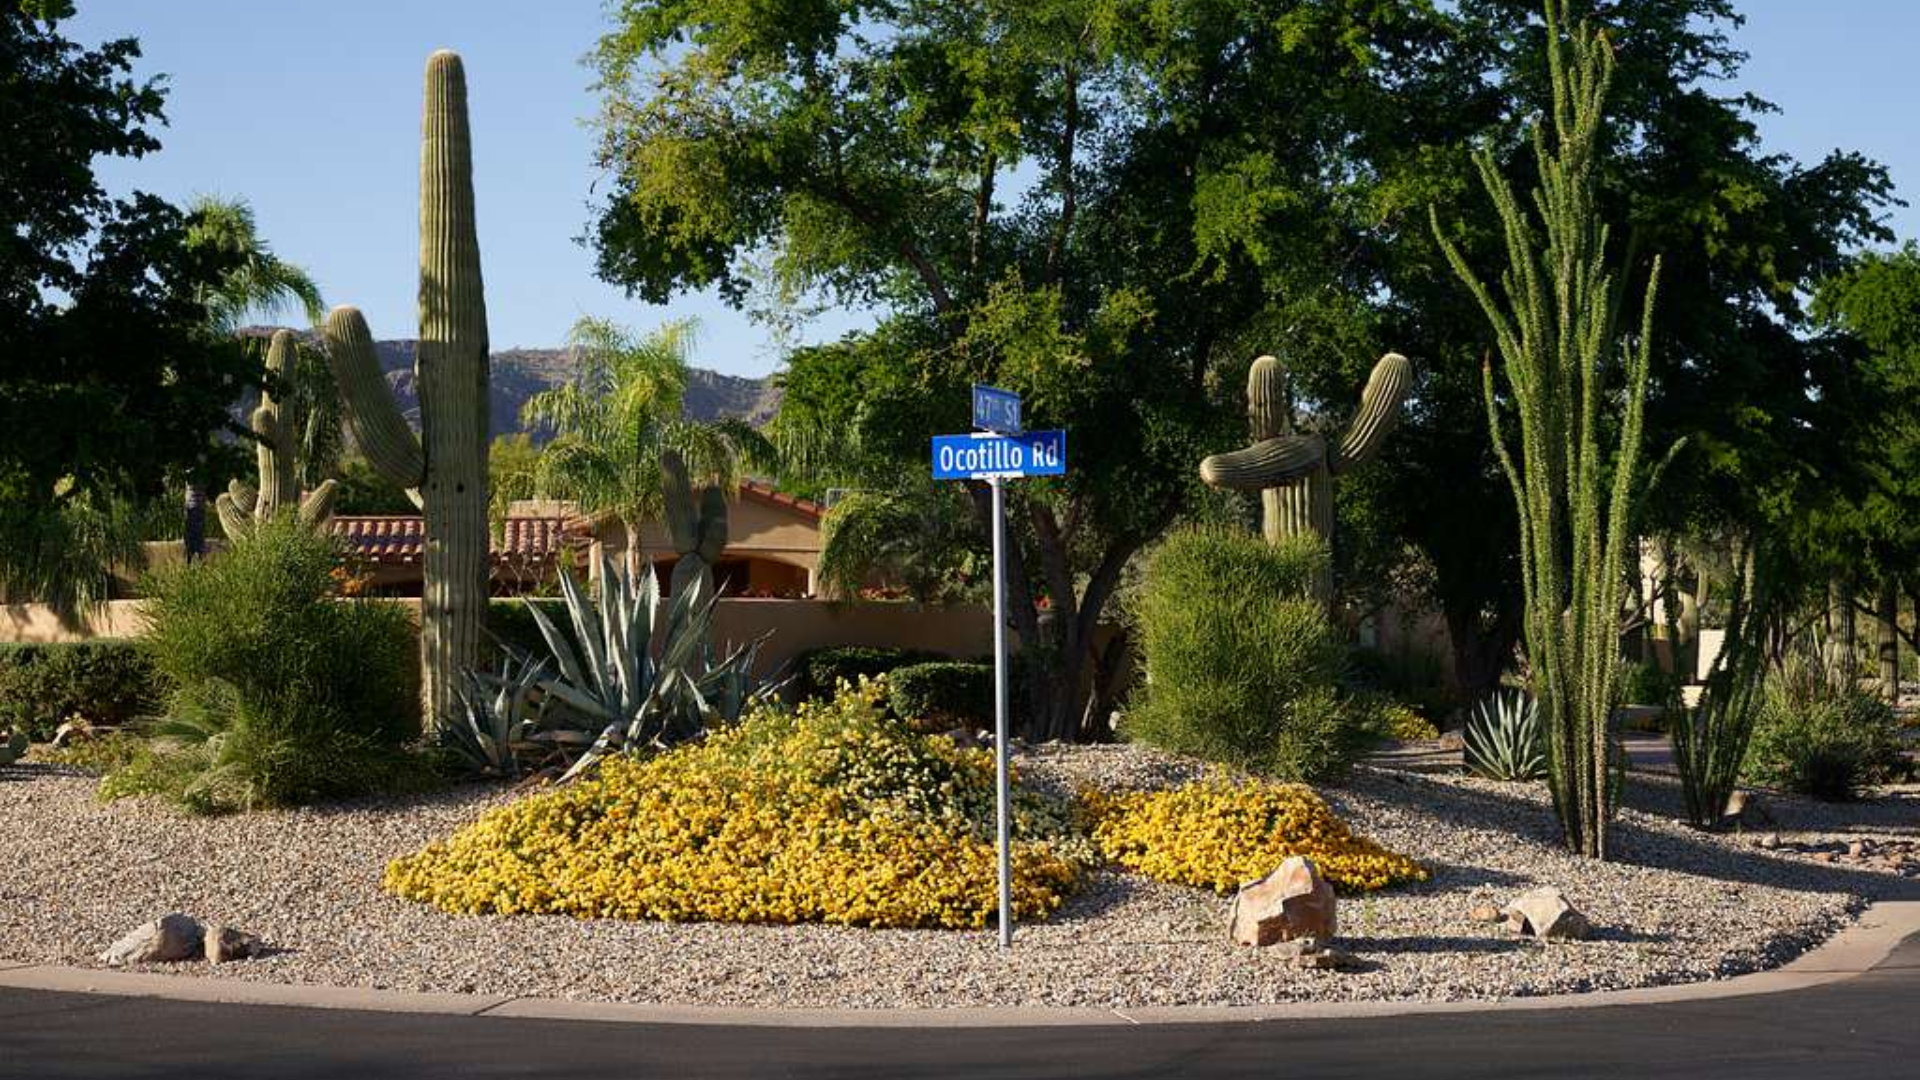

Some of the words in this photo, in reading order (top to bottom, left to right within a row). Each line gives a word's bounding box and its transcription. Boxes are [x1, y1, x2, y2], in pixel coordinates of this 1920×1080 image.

[1004, 400, 1019, 427] St
[940, 440, 1023, 472] Ocotillo
[1032, 438, 1058, 468] Rd
